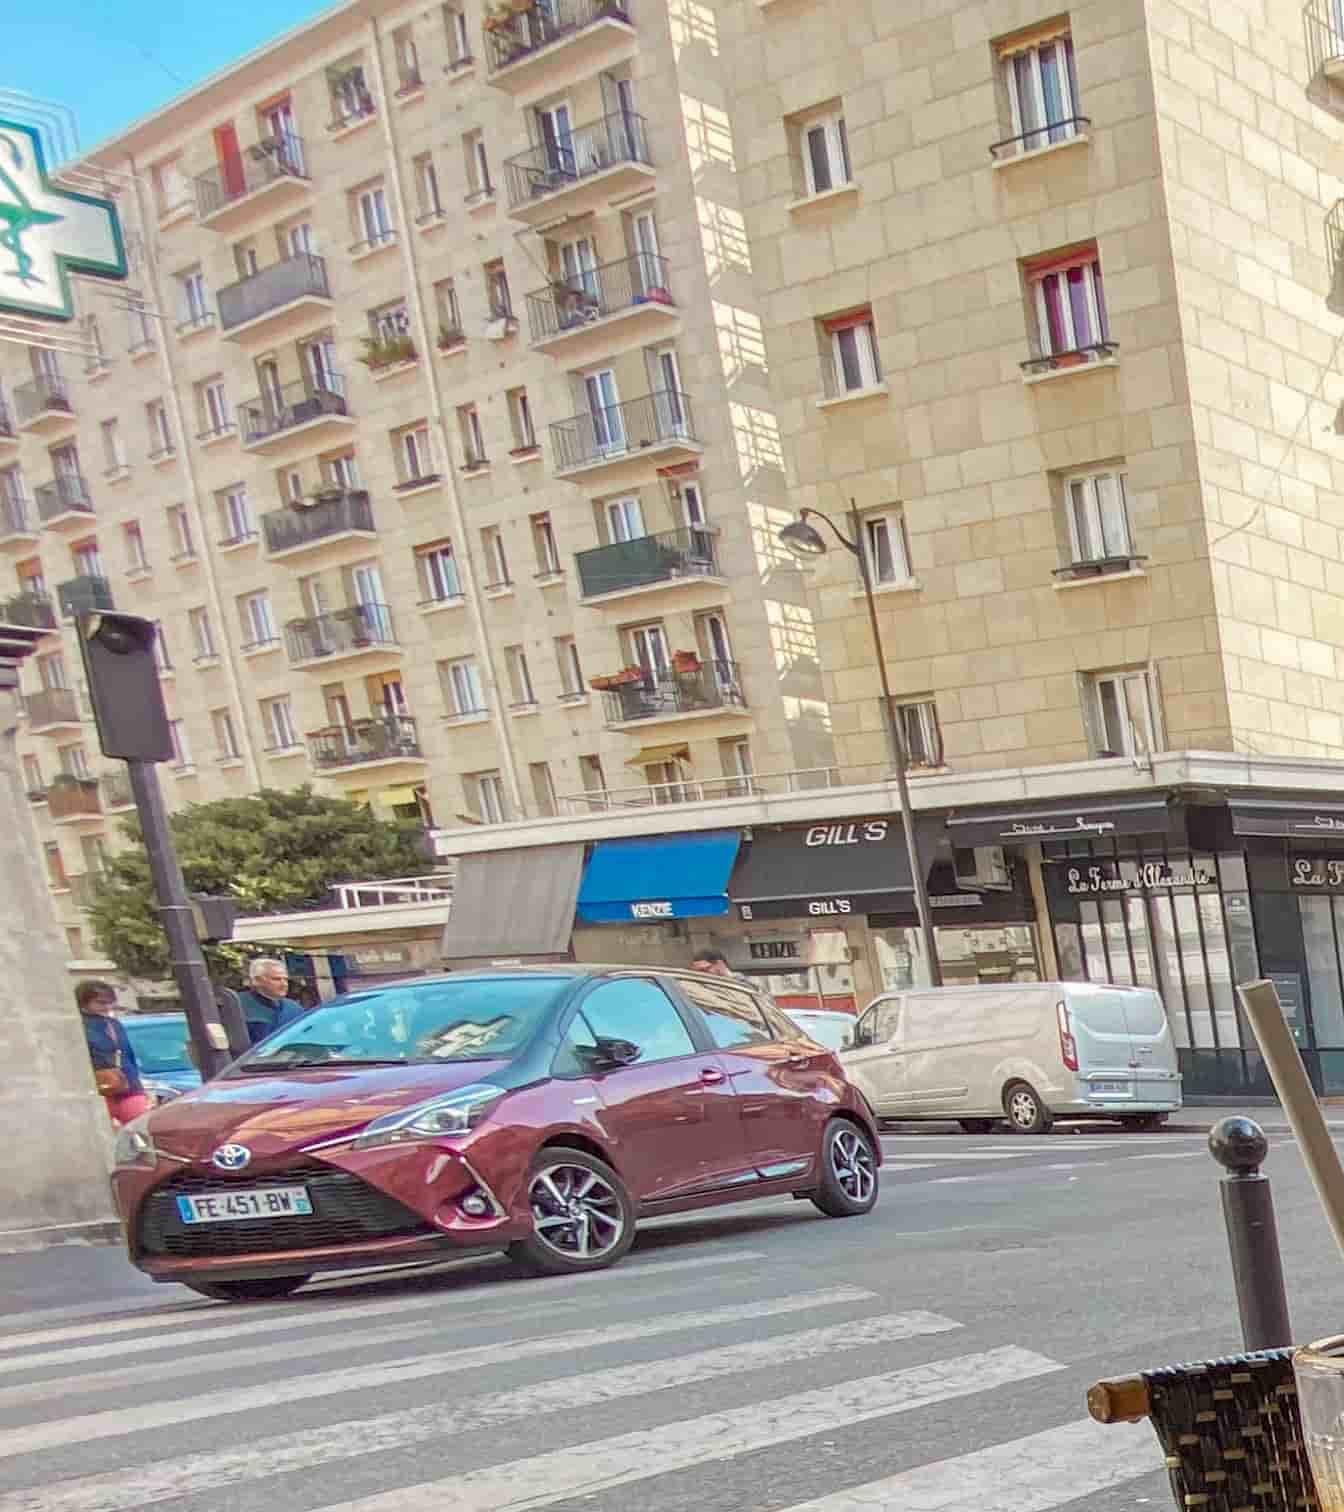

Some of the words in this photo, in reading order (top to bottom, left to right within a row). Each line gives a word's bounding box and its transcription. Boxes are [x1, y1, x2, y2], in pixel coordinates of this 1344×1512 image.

[806, 820, 889, 846] GILL'S
[1068, 868, 1088, 893] La
[1088, 866, 1132, 891] Ferme
[1134, 863, 1210, 889] d'Alexandre
[1293, 859, 1326, 885] La
[809, 899, 851, 915] GILL'S
